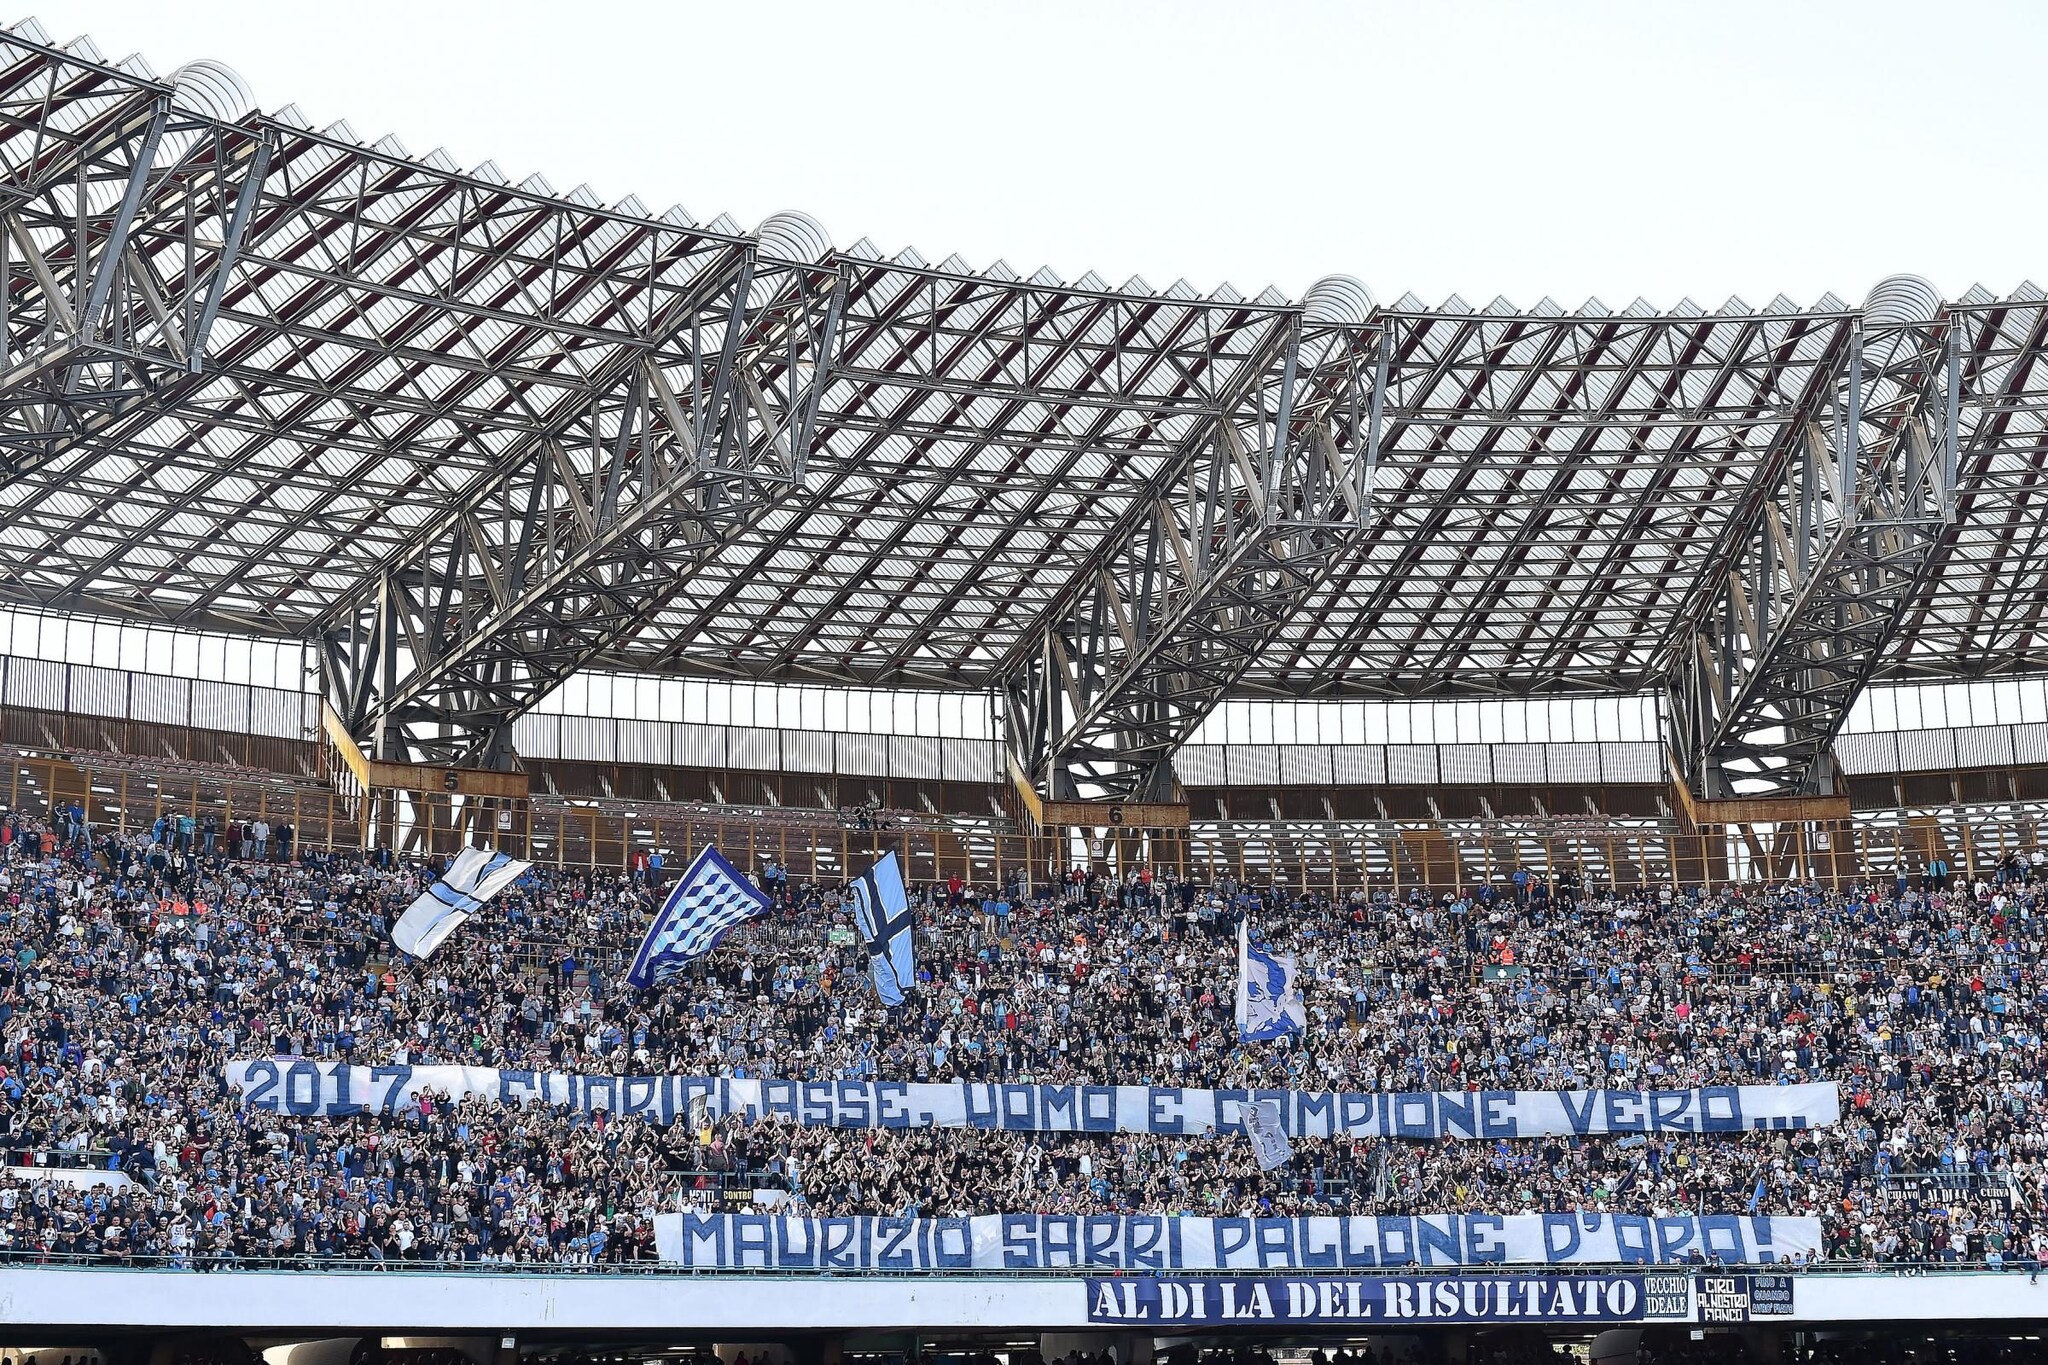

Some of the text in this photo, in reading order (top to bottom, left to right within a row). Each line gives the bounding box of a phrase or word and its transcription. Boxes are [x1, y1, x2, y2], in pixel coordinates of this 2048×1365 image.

[444, 772, 458, 790] 5
[1108, 807, 1122, 823] 6
[245, 1061, 413, 1118] 2017
[964, 1083, 1117, 1131] UOMO
[1149, 1087, 1183, 1135] E
[724, 1190, 752, 1200] CONTRO
[1981, 1188, 2009, 1197] CURVA
[683, 1213, 1774, 1269] MAURIZIO SARRI PALLONE D'ORO!
[1644, 1277, 1687, 1294] VECCHIO
[1705, 1279, 1735, 1293] CIRO
[1779, 1277, 1787, 1288] A
[1092, 1280, 1637, 1318] AL DI LA DEL RISULTATO
[1754, 1289, 1790, 1301] QUANDO
[1646, 1296, 1687, 1314] IDEALE
[1704, 1308, 1743, 1321] FIANCO
